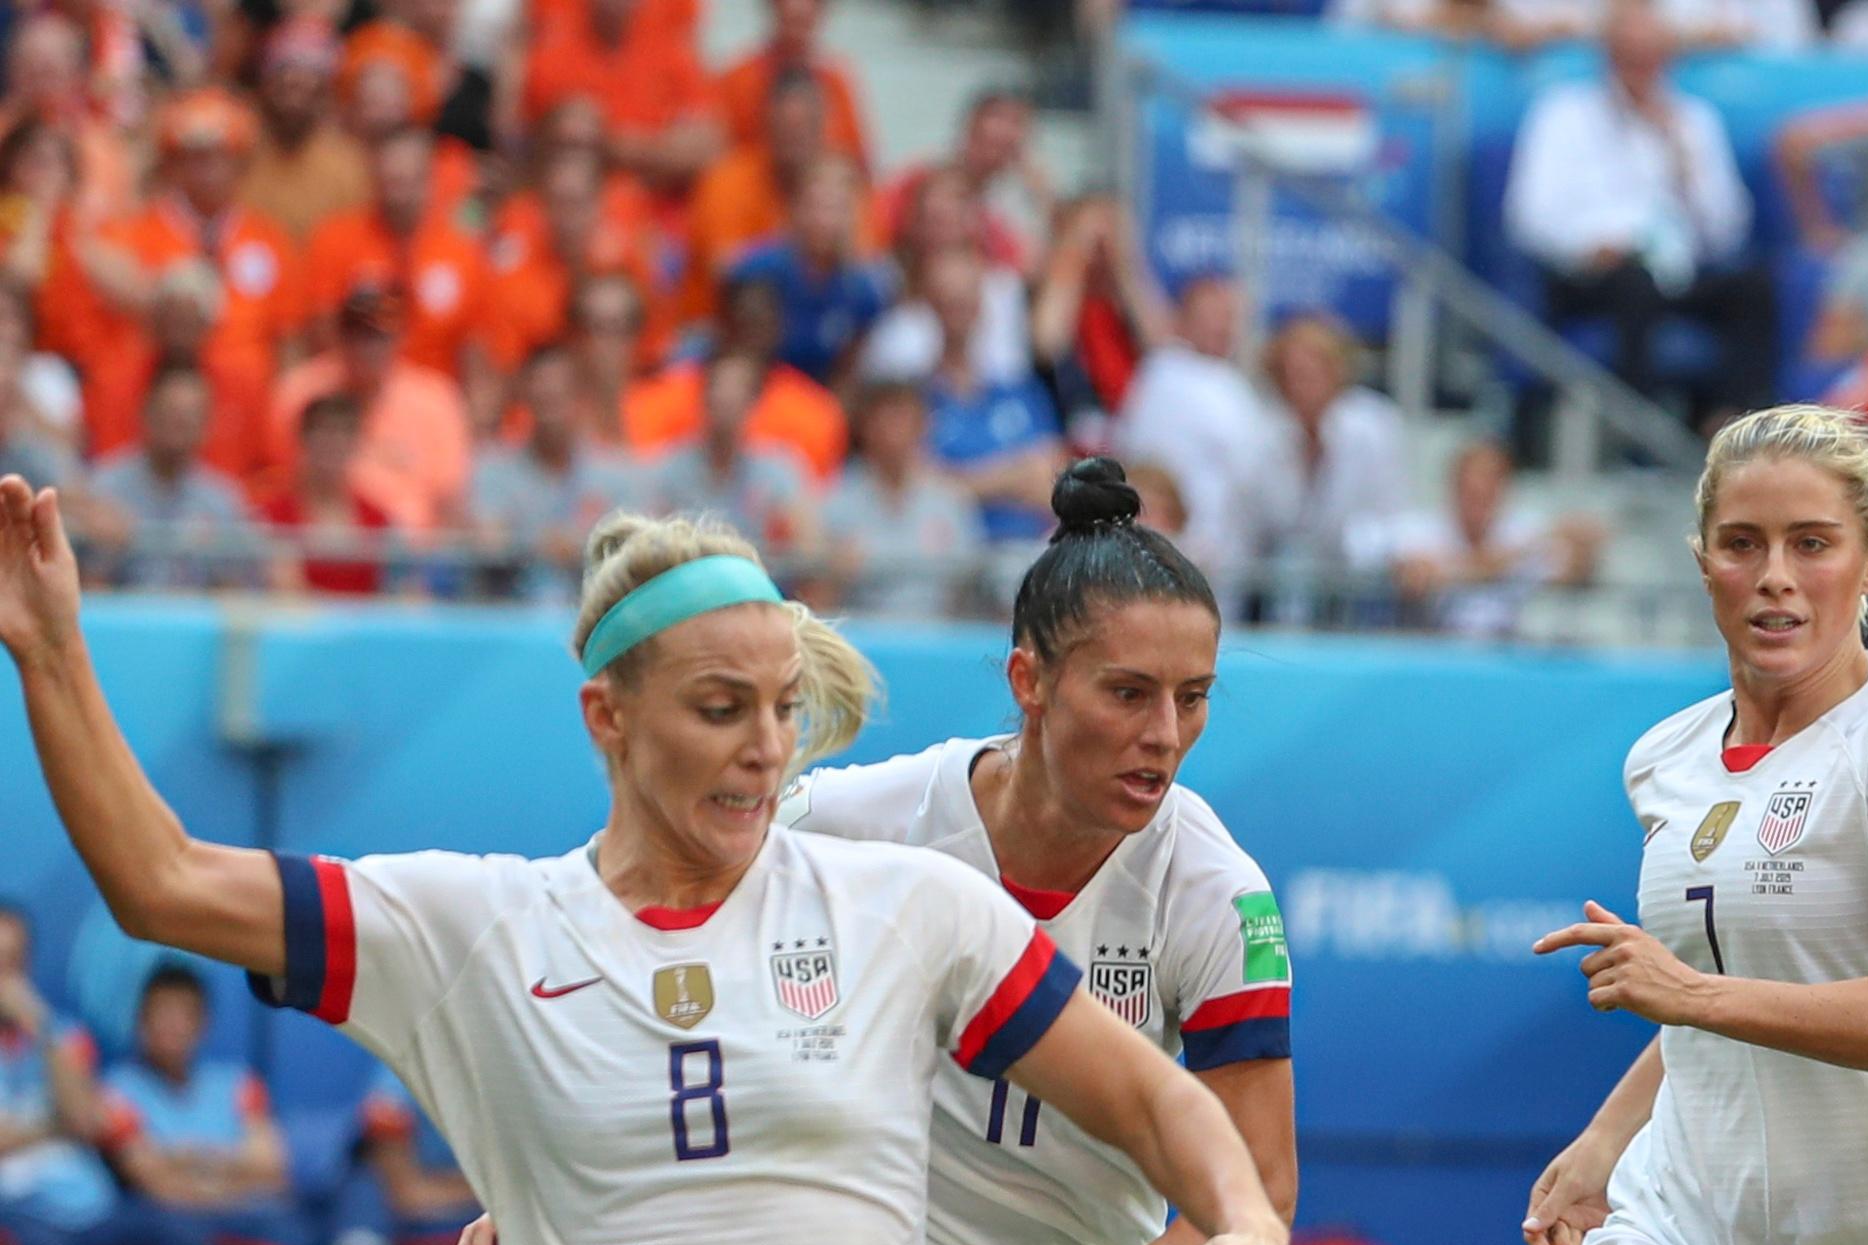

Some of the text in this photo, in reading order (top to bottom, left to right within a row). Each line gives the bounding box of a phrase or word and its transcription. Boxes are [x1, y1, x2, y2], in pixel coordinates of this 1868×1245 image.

[1770, 797, 1808, 819] USA
[1762, 861, 1804, 872] NETHERLANDS
[1775, 873, 1791, 883] 2019
[1752, 884, 1793, 895] LYON FRANCE
[1686, 885, 1727, 975] 7
[778, 957, 829, 983] USA
[1097, 968, 1146, 996] USA
[669, 1037, 730, 1162] 8
